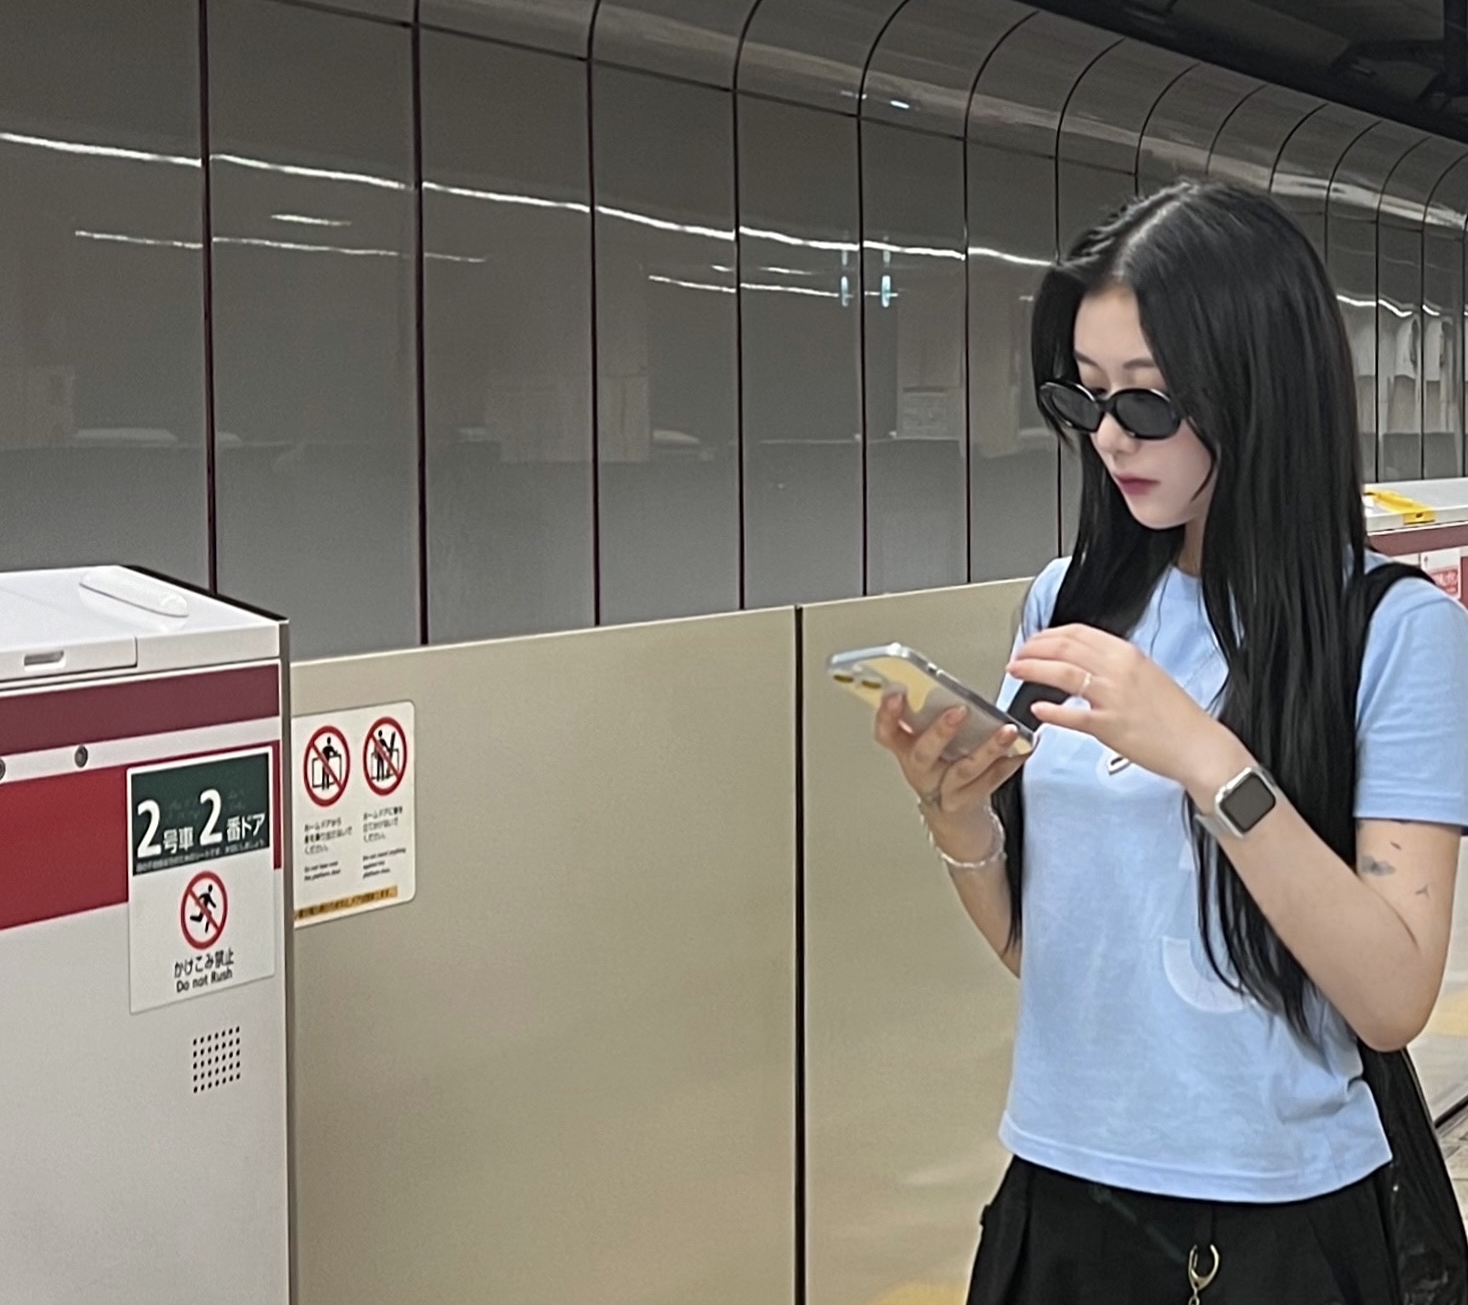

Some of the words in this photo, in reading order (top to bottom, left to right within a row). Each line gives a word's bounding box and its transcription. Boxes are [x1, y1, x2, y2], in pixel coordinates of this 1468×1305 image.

[175, 947, 234, 979] かけこみ禁止
[176, 980, 190, 993] Do
[192, 974, 208, 988] not
[211, 969, 233, 984] Rush
